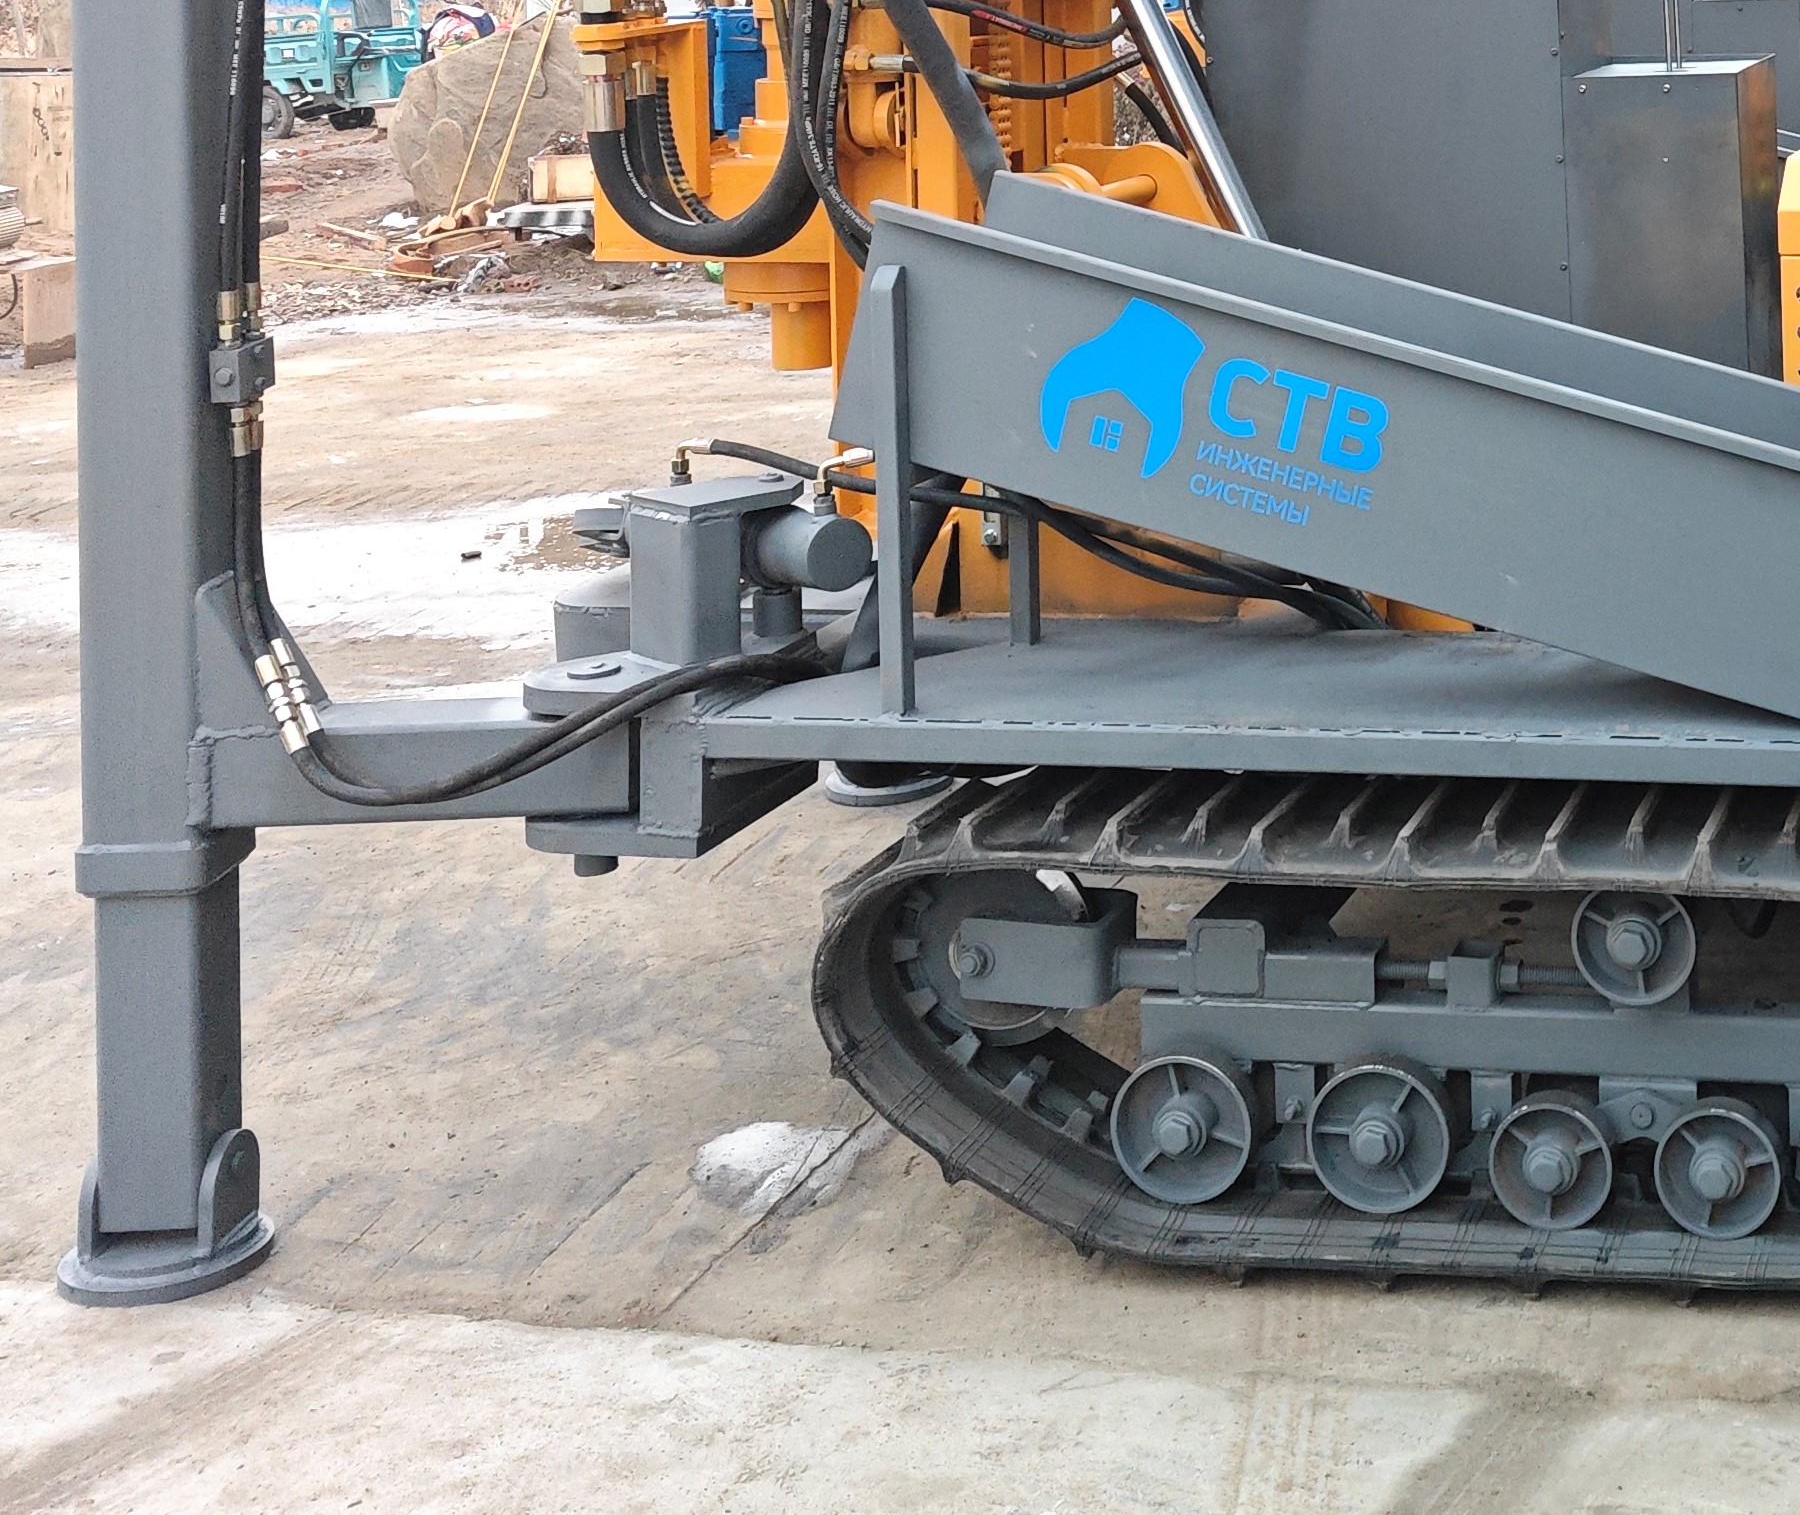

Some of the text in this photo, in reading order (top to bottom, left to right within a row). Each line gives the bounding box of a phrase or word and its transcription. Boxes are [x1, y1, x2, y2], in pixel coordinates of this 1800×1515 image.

[839, 202, 873, 232] HYDRAULIC
[1208, 358, 1390, 473] СТВ
[1189, 472, 1312, 527] СИСТЕМЫ
[1196, 439, 1375, 511] ИНЖЕНЕРНЫЕ
